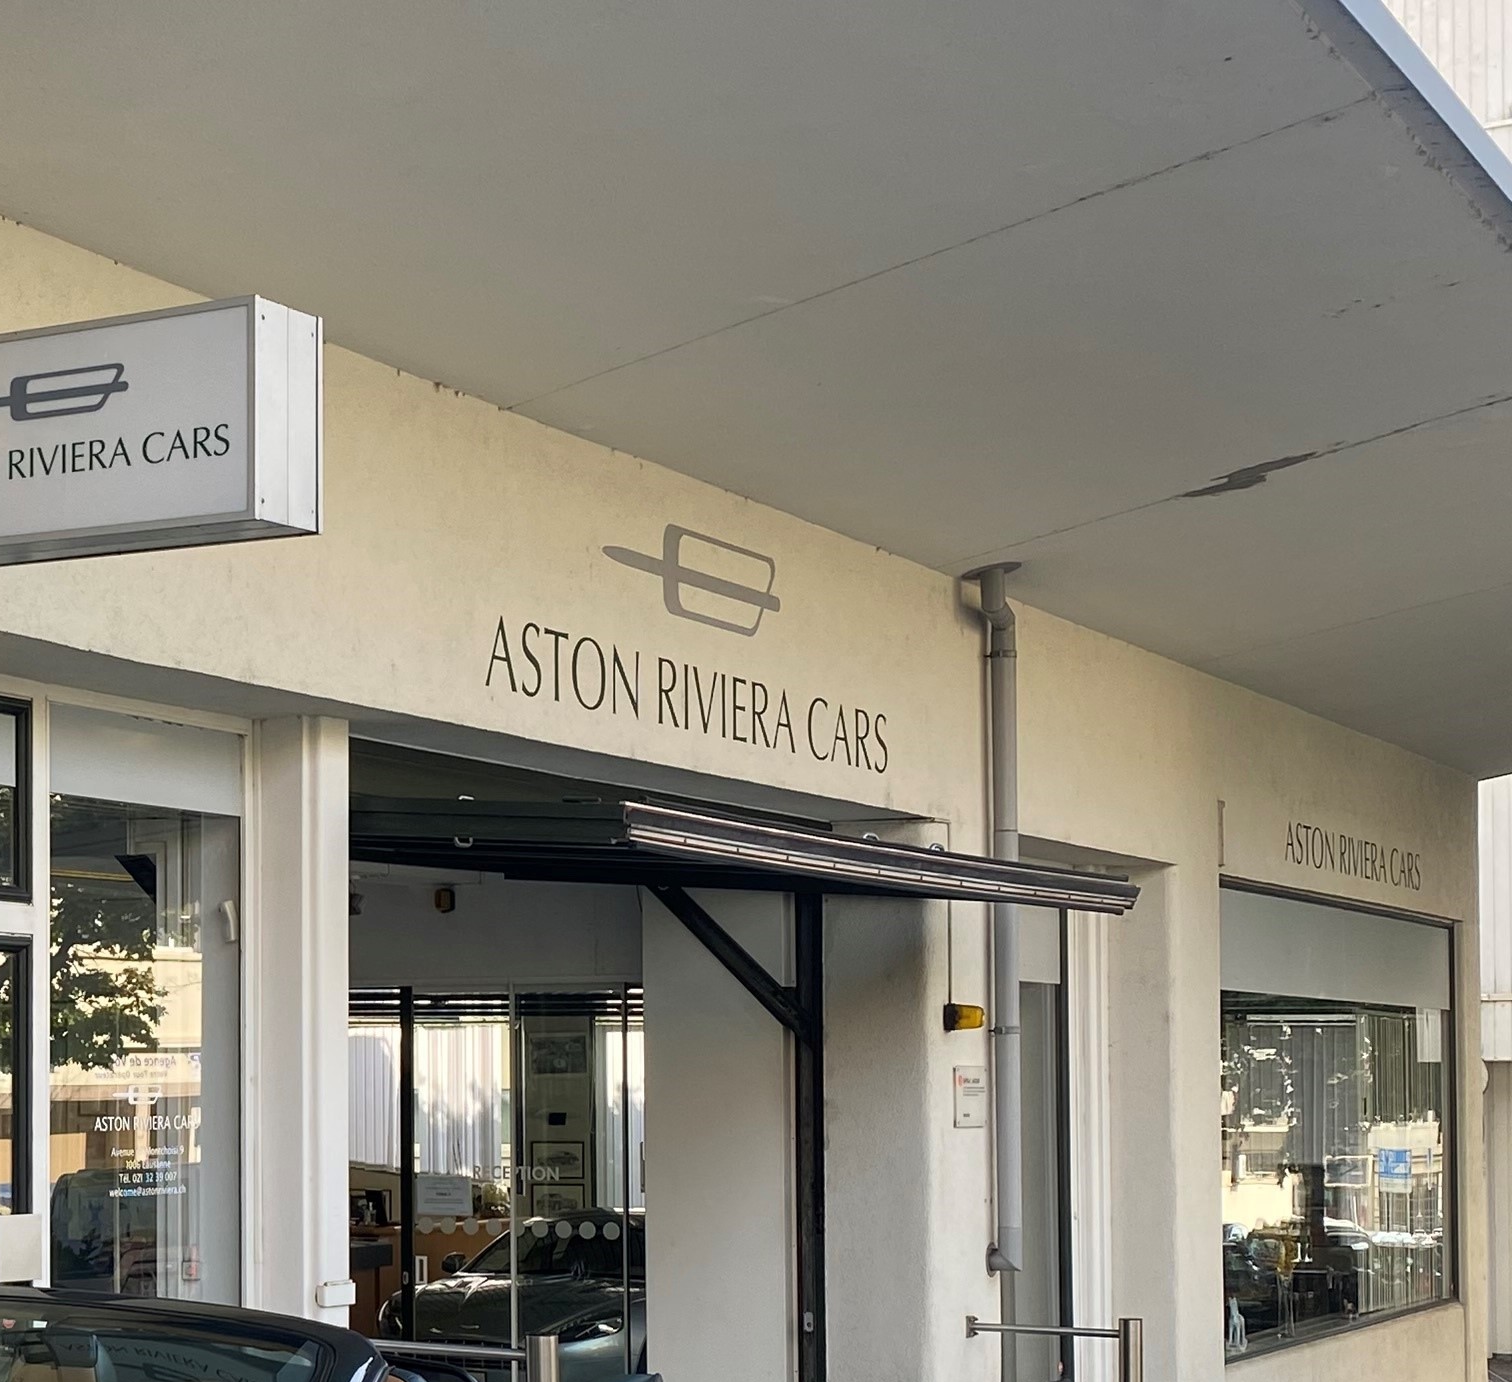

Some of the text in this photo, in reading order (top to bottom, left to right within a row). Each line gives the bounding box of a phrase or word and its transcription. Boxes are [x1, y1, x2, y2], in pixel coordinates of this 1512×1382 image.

[8, 436, 132, 479] RIVIERA
[141, 423, 230, 464] CARS
[485, 615, 888, 774] ASTON RIVIERA CARS
[1284, 820, 1421, 891] ASTON RIVIERA CARS
[94, 1115, 130, 1132] ASTON
[178, 1144, 185, 1156] 9
[131, 1173, 144, 1184] 021
[145, 1172, 154, 1183] 32
[155, 1172, 164, 1183] 39
[164, 1171, 178, 1182] 007
[472, 1165, 560, 1182] RCETION
